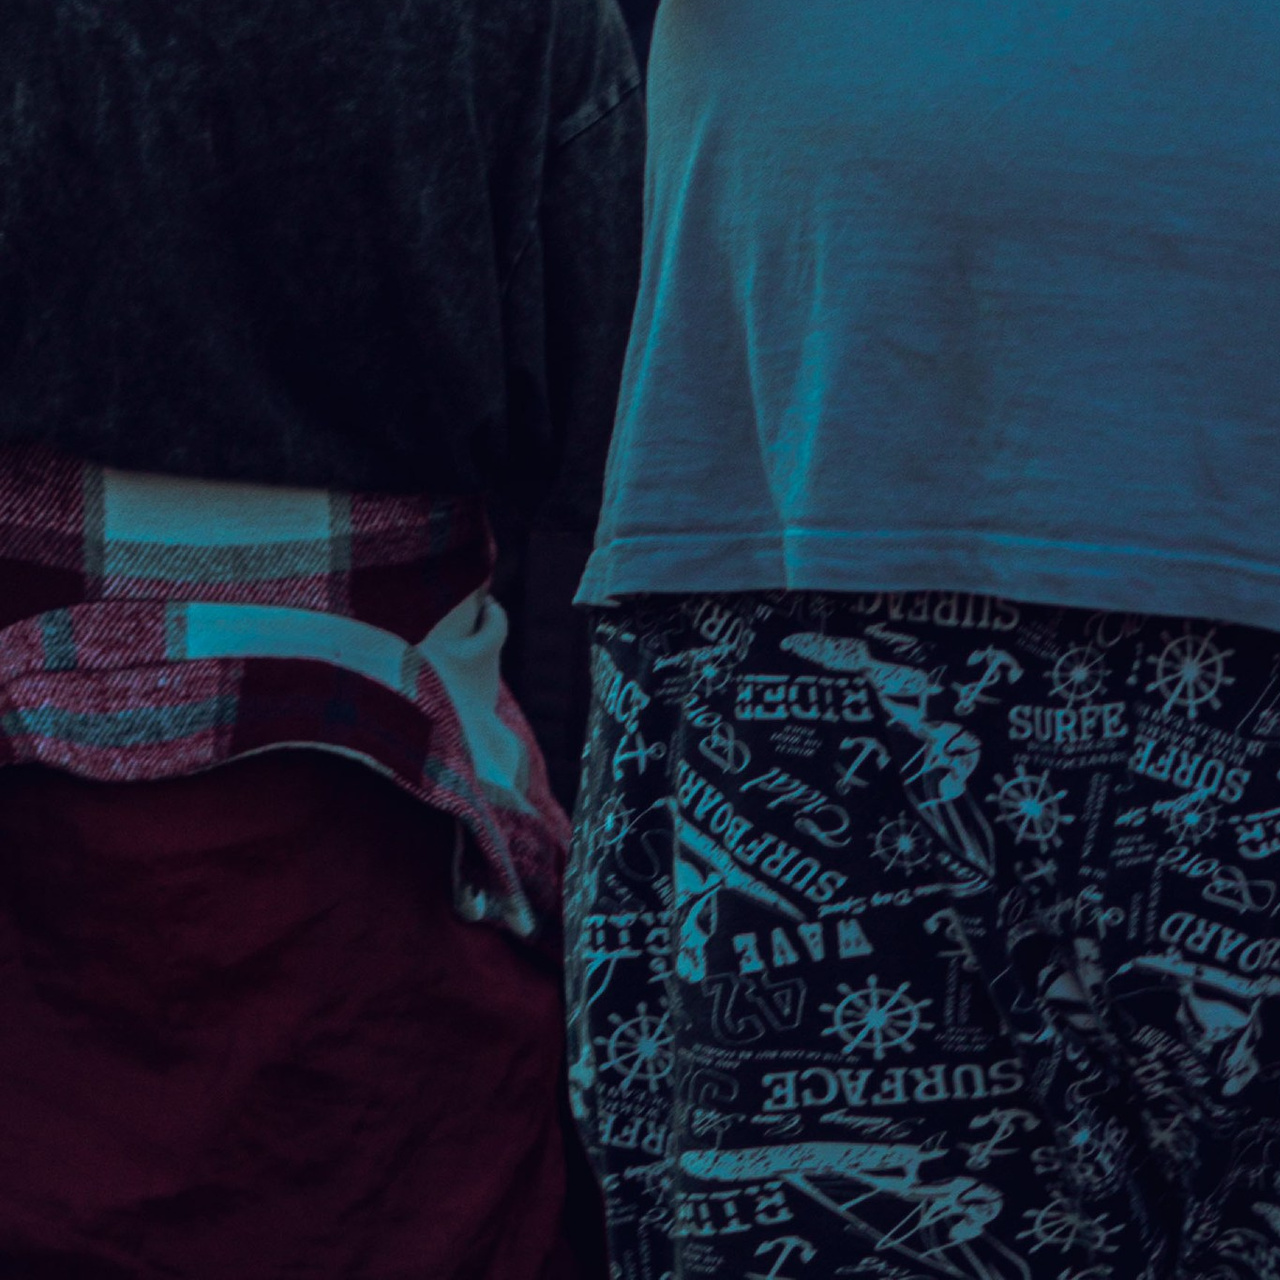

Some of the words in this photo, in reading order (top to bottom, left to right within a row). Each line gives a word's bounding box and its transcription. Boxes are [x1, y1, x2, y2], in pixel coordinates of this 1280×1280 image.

[736, 673, 875, 722] RIDER
[734, 920, 872, 975] WAVE
[762, 1057, 1025, 1113] SURFACE
